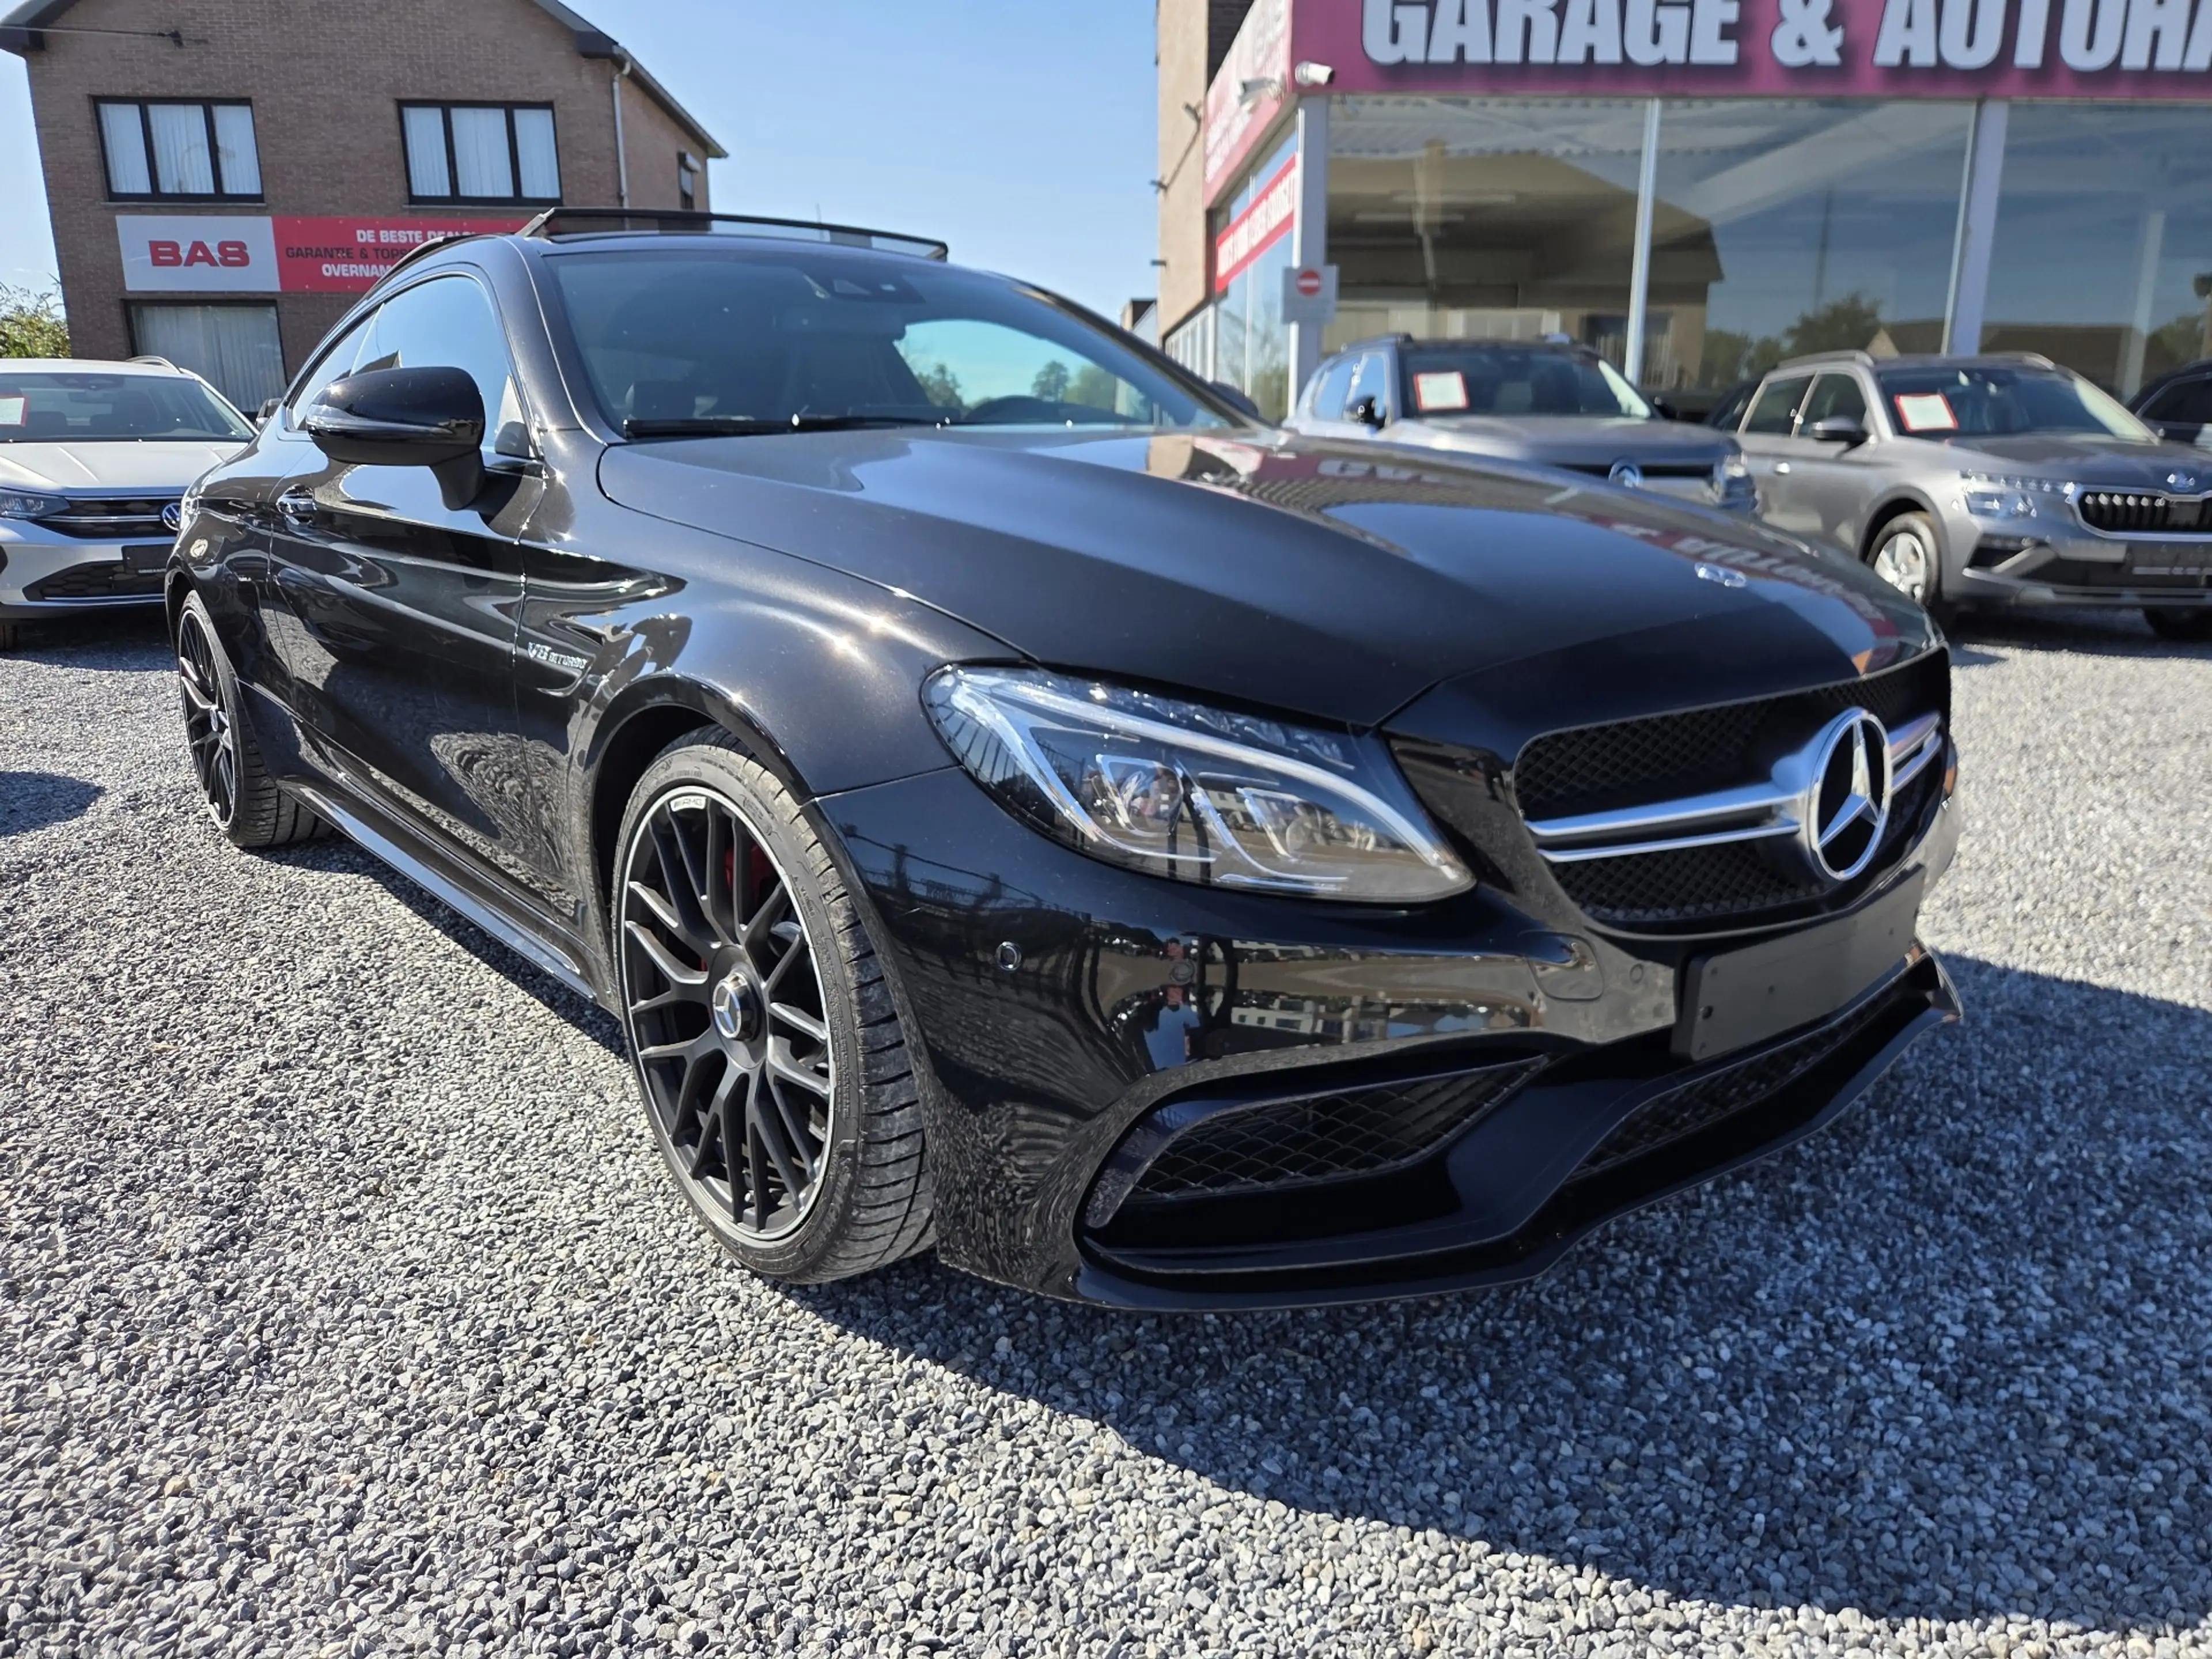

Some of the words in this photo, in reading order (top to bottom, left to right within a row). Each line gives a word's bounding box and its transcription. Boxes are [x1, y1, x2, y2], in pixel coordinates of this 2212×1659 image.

[1361, 0, 1740, 66] GARAGE
[1771, 0, 1843, 67] &
[1873, 0, 2212, 72] AUTOH
[357, 229, 376, 243] DE
[380, 230, 423, 243] BESTE
[148, 240, 250, 267] BAS
[286, 248, 353, 259] GARANTIE
[359, 248, 369, 259] &
